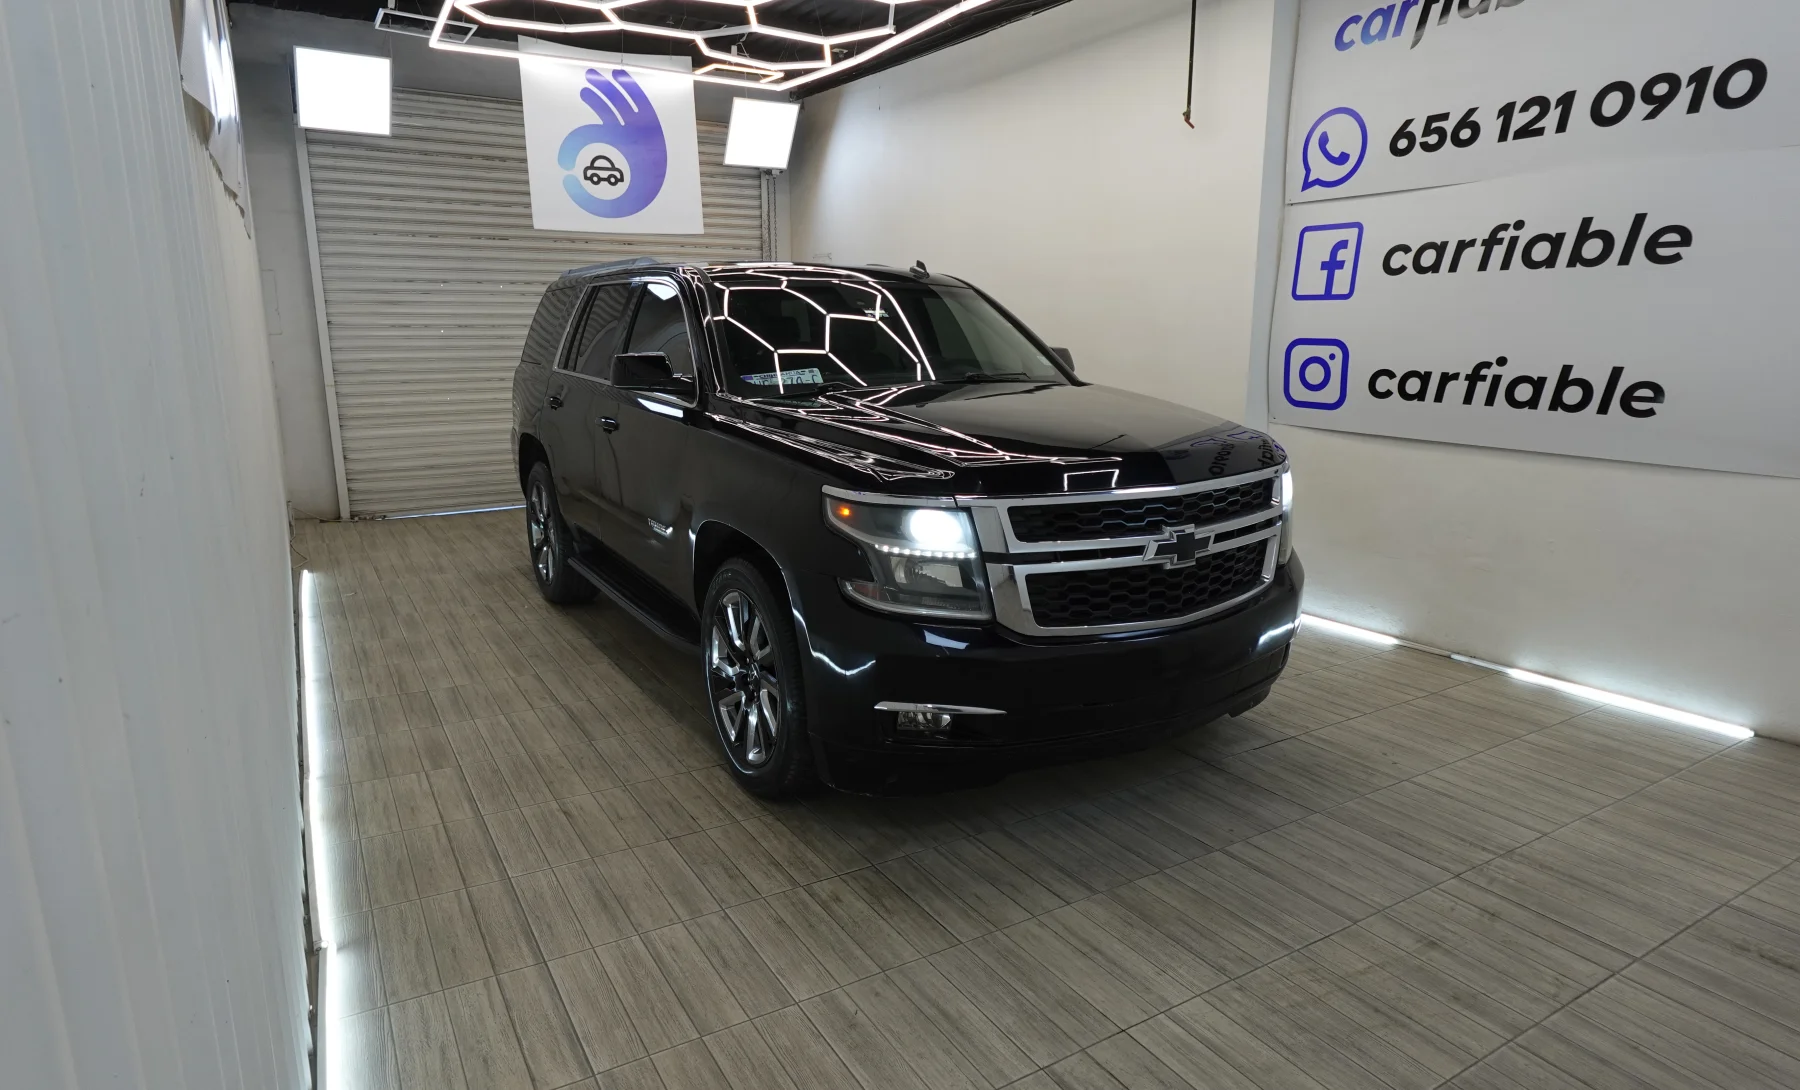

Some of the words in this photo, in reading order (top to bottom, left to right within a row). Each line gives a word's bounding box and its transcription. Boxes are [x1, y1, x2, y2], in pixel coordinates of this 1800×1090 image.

[1388, 107, 1482, 158] 656
[1496, 89, 1578, 144] 121
[1589, 57, 1768, 128] 0910
[1381, 212, 1694, 277] carfiable
[1367, 355, 1666, 419] carfiable
